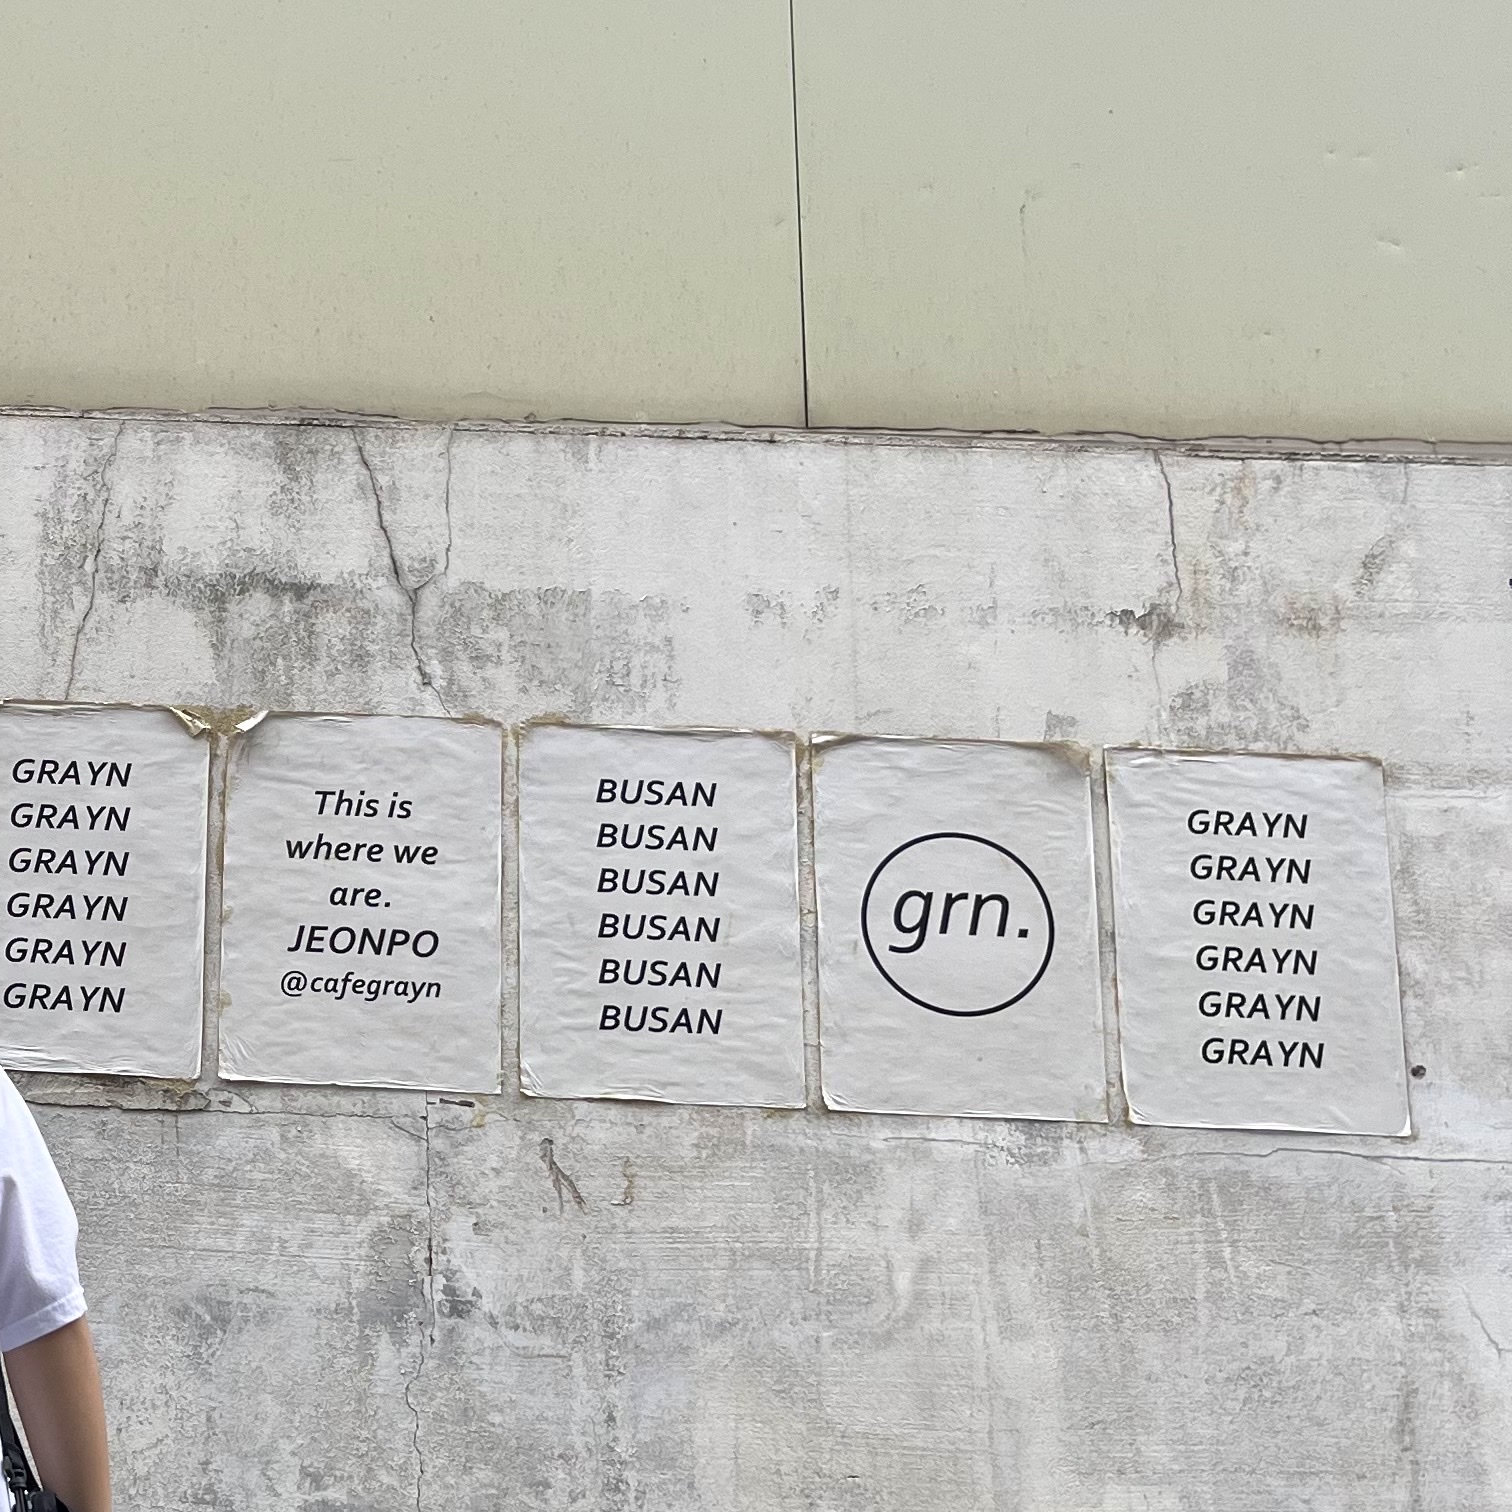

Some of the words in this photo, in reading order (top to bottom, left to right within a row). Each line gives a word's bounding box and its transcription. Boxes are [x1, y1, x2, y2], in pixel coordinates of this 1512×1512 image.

[12, 758, 133, 788] GRAYN
[314, 789, 380, 818] This
[387, 791, 413, 819] is
[595, 778, 717, 808] BUSAN
[10, 802, 131, 832] GRAYN
[1187, 809, 1308, 839] GRAYN
[285, 833, 384, 863] where
[393, 844, 439, 866] we
[596, 823, 719, 852] BUSAN
[8, 847, 130, 877] GRAYN
[1190, 854, 1312, 884] GRAYN
[329, 886, 391, 908] are.
[596, 867, 720, 897] BUSAN
[6, 892, 129, 922] GRAYN
[888, 890, 1029, 954] grn.
[1193, 899, 1315, 930] GRAYN
[286, 924, 439, 958] JEONPO
[597, 913, 721, 943] BUSAN
[5, 937, 127, 967] GRAYN
[1196, 945, 1318, 976] GRAYN
[280, 970, 441, 1004] @cafegrayn
[598, 958, 722, 989] BUSAN
[3, 982, 126, 1013] GRAYN
[1198, 990, 1321, 1022] GRAYN
[598, 1004, 723, 1035] BUSAN
[1201, 1037, 1325, 1069] GRAYN
